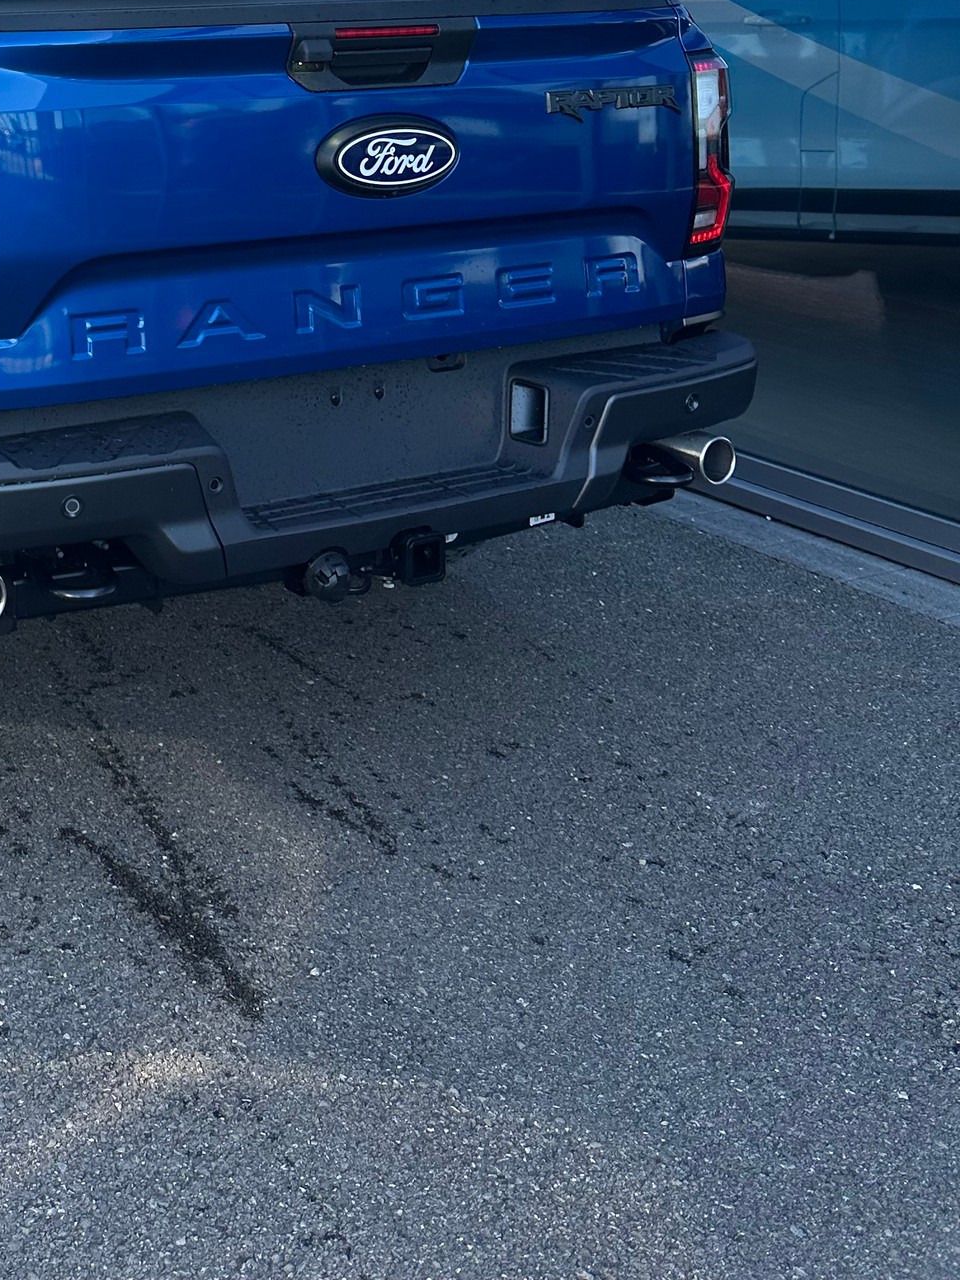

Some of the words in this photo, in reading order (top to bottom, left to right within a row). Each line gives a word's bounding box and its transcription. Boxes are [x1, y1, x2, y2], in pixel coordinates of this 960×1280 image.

[546, 85, 681, 123] RAPTOR
[360, 138, 435, 176] Ford
[65, 252, 640, 361] RANGER
